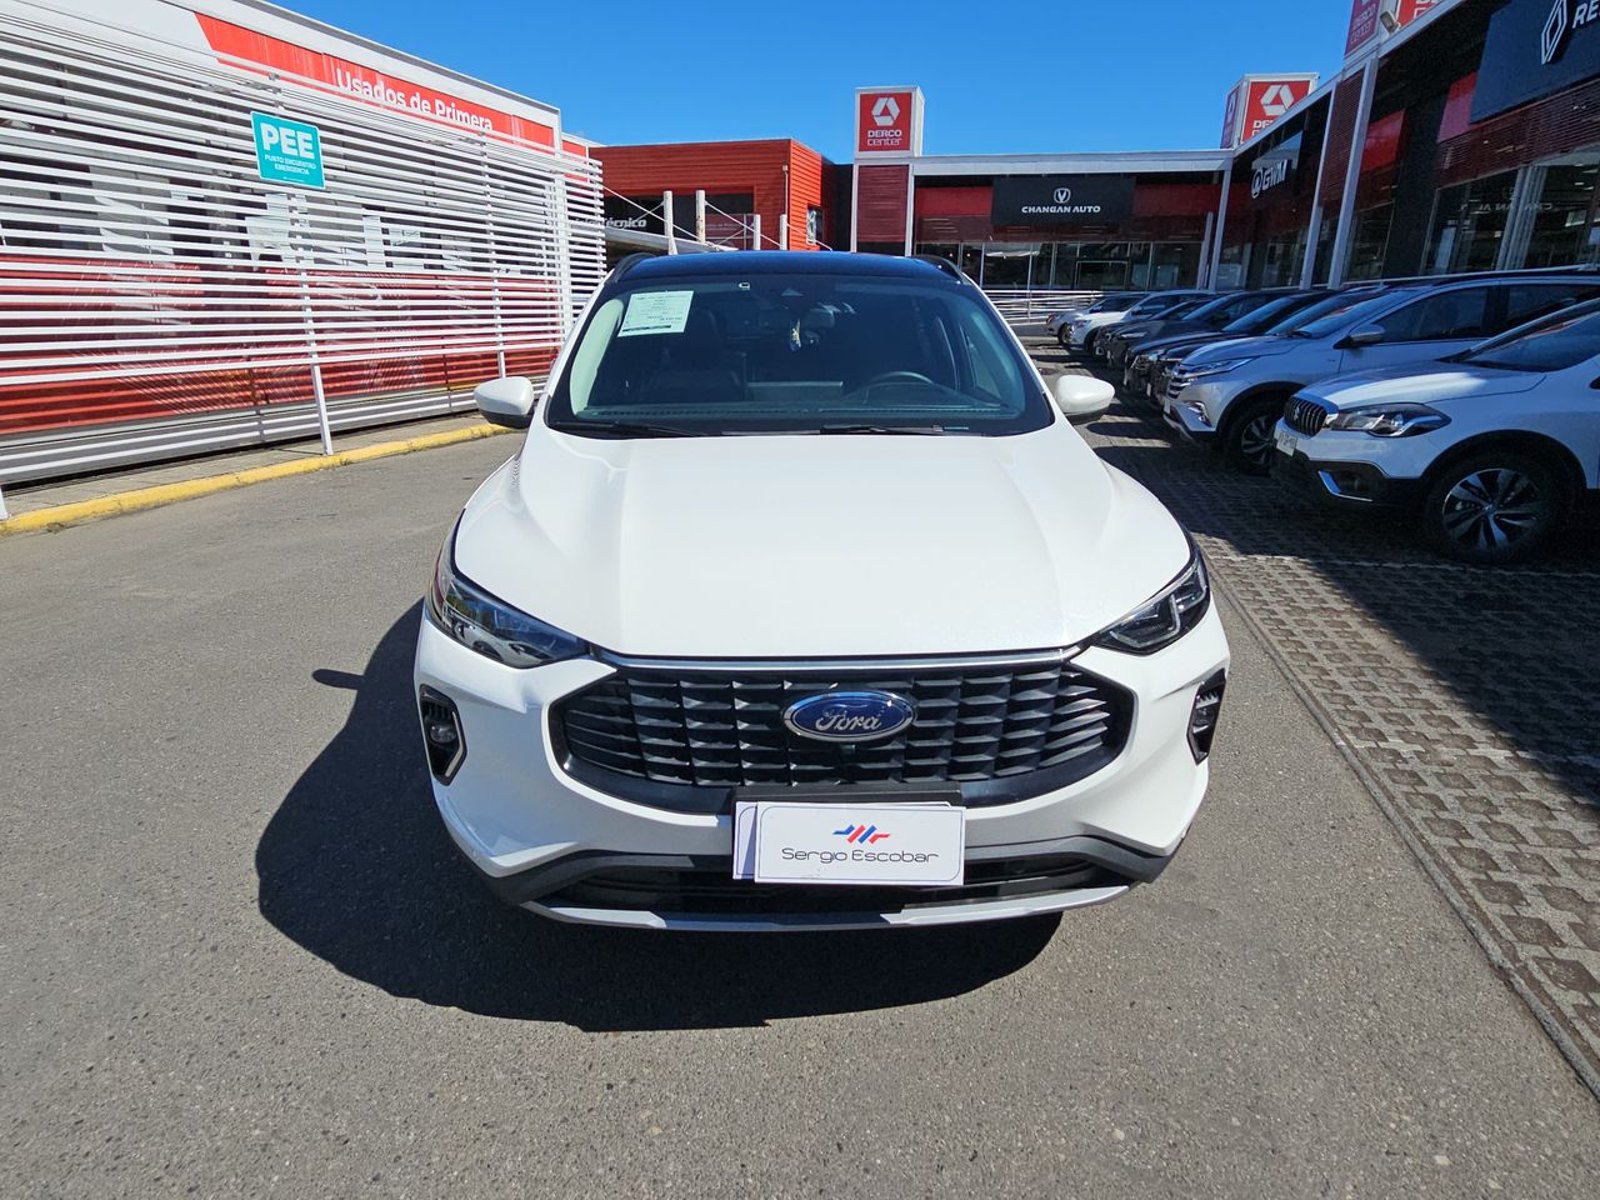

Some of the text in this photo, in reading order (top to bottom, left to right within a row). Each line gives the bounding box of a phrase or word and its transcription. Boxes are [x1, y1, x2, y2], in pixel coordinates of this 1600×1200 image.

[336, 68, 494, 132] Usados de Primera
[867, 130, 902, 138] DERCO
[260, 122, 315, 160] PEE
[867, 138, 902, 146] center
[265, 154, 284, 163] PUNTO
[275, 163, 310, 175] EMERGENCIA
[1262, 159, 1288, 191] GWM
[1021, 204, 1101, 214] CHANGAN AUTO
[604, 217, 647, 229] écnico
[815, 709, 884, 732] Ford
[781, 847, 939, 865] Sergio Escobar
